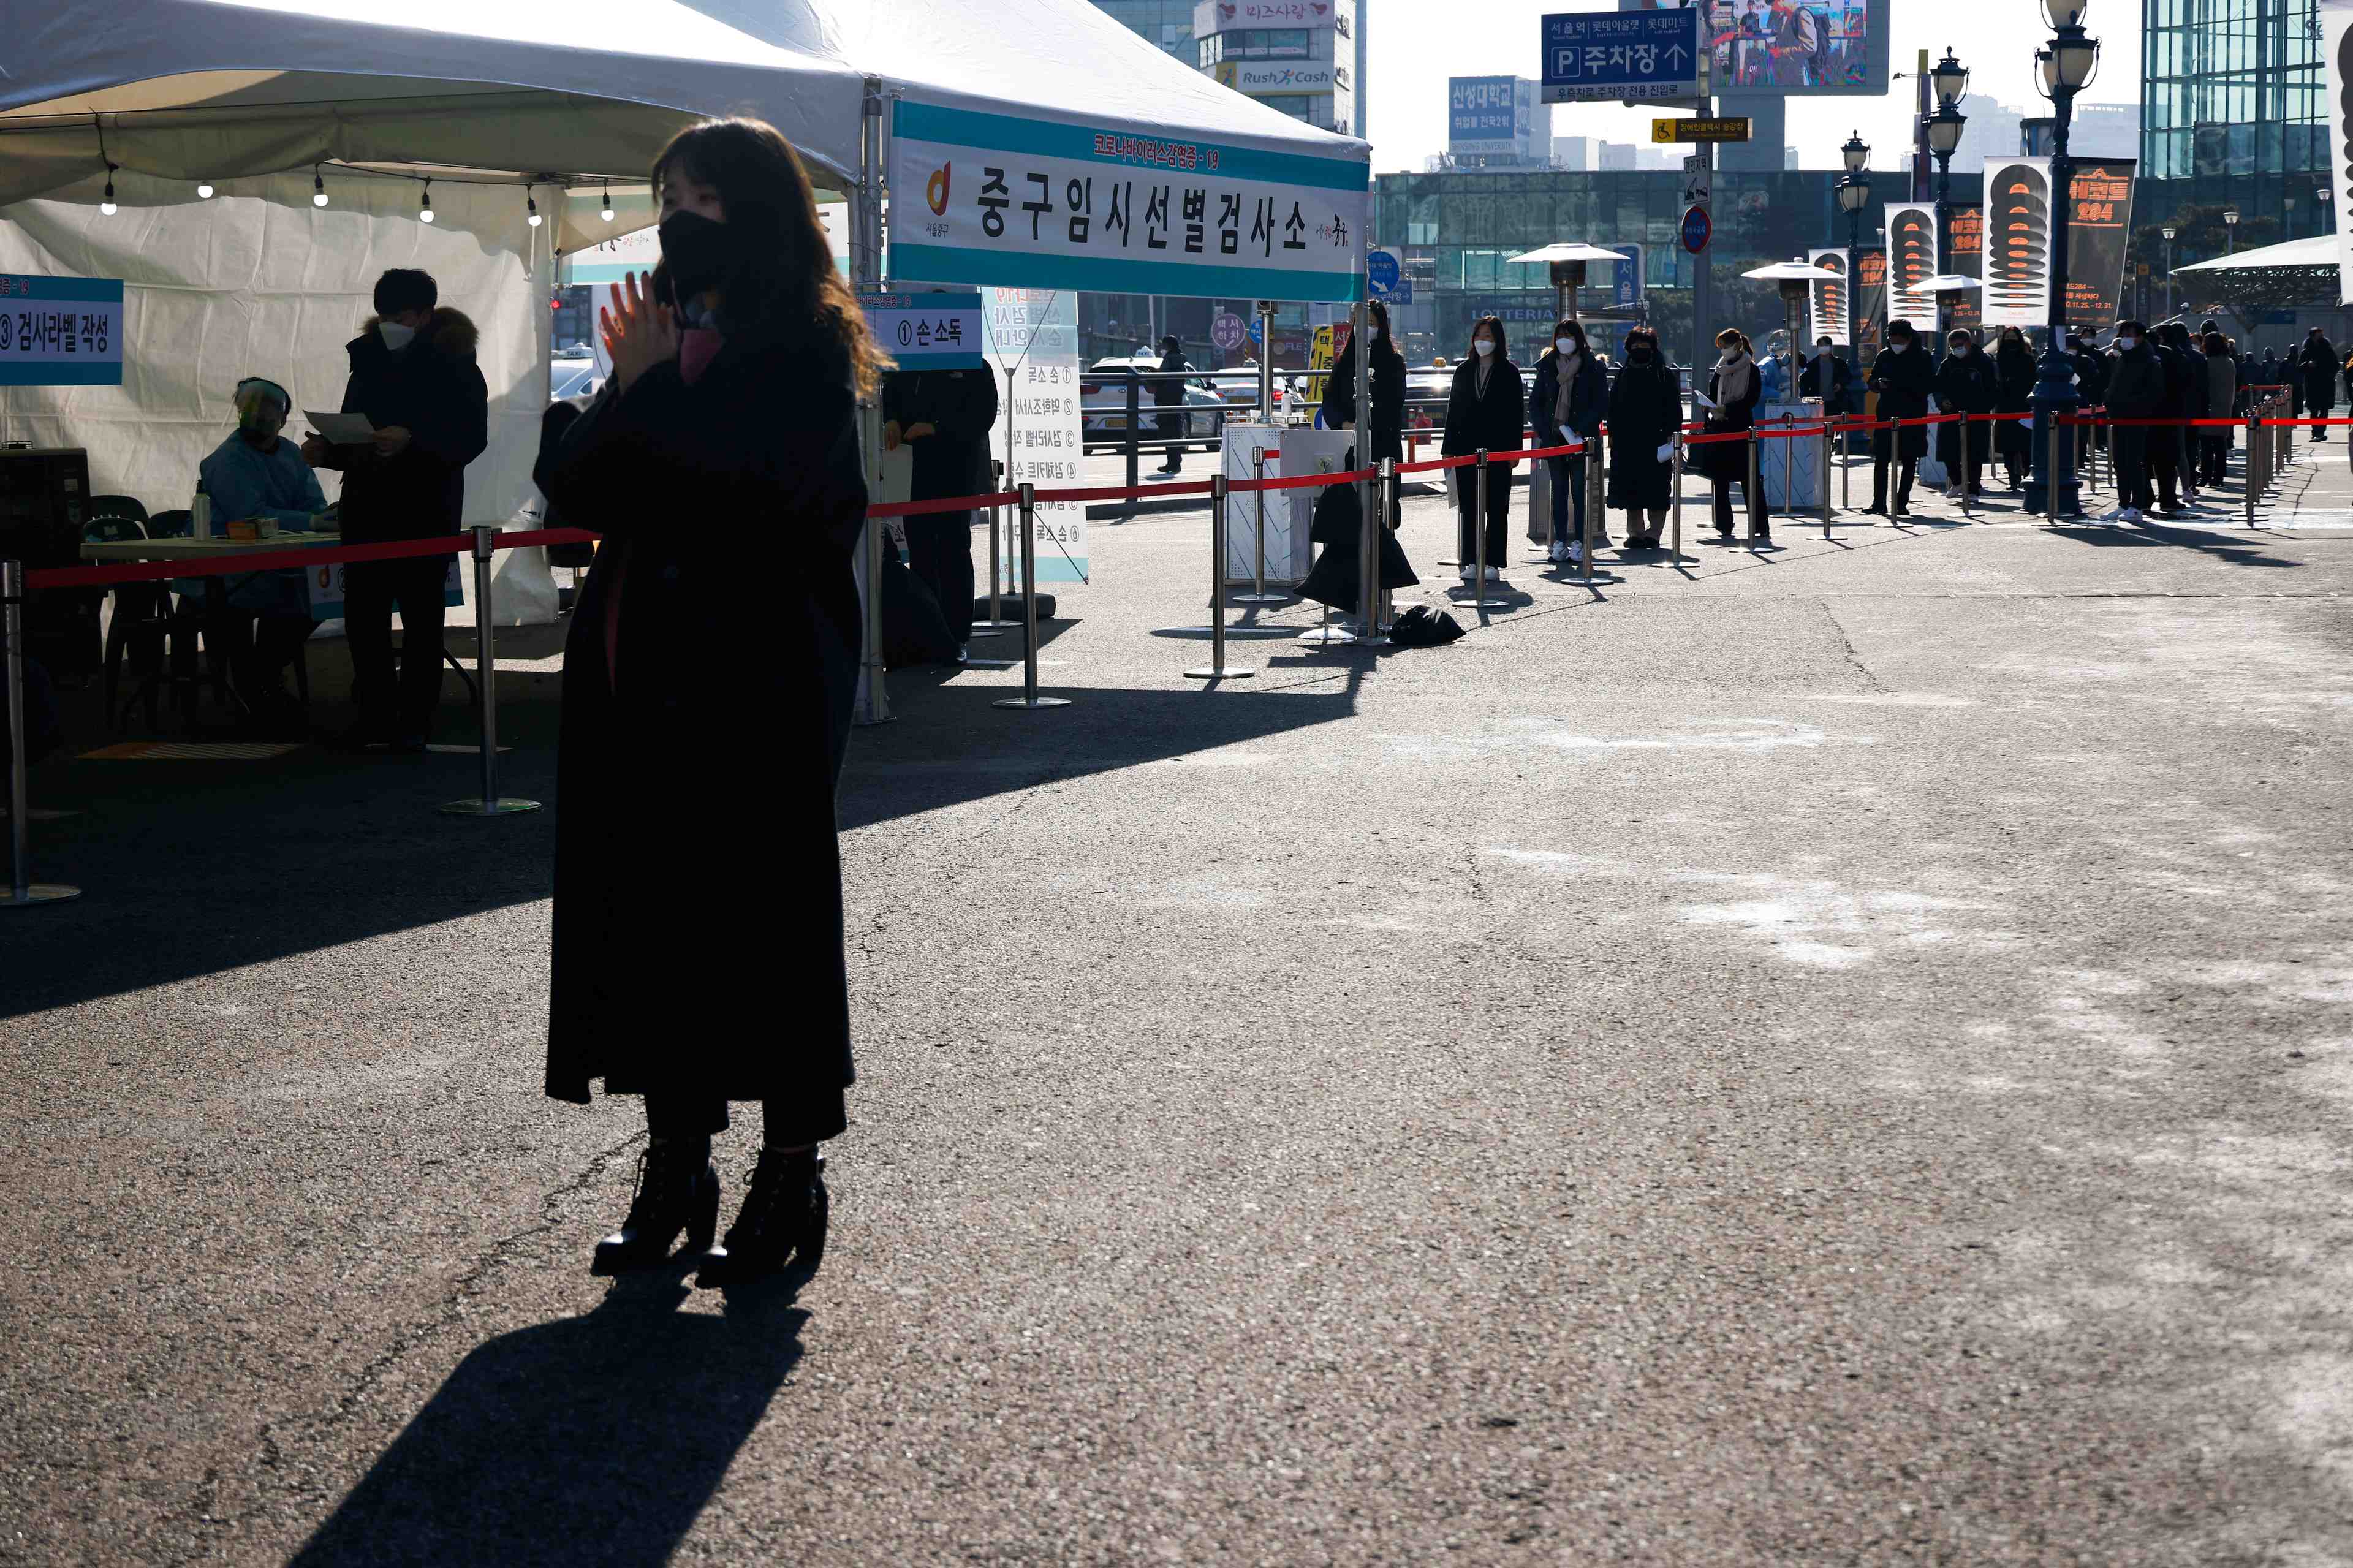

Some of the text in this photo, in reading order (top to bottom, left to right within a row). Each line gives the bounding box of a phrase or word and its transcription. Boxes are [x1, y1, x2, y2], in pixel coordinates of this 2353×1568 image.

[1246, 4, 1305, 20] 미즈사랑
[1552, 17, 1688, 34] 서울역 롯데아울렛 롯데마트
[1558, 44, 1659, 75] P 주차장
[1243, 72, 1277, 83] Rush
[1295, 72, 1328, 83] Cash
[1453, 83, 1511, 110] 신성대학교
[1558, 85, 1678, 99] 우측차로 주차장 전용 진입로
[1093, 134, 1197, 170] 코로나바이러스감염증
[977, 167, 1306, 257] 중구임시선별검사소
[2077, 202, 2113, 221] 284
[1471, 308, 1555, 320] LOTTERIA
[18, 312, 77, 353] 검사라벨
[81, 313, 108, 354] 작성
[916, 318, 931, 346] 손
[934, 318, 962, 346] 소독
